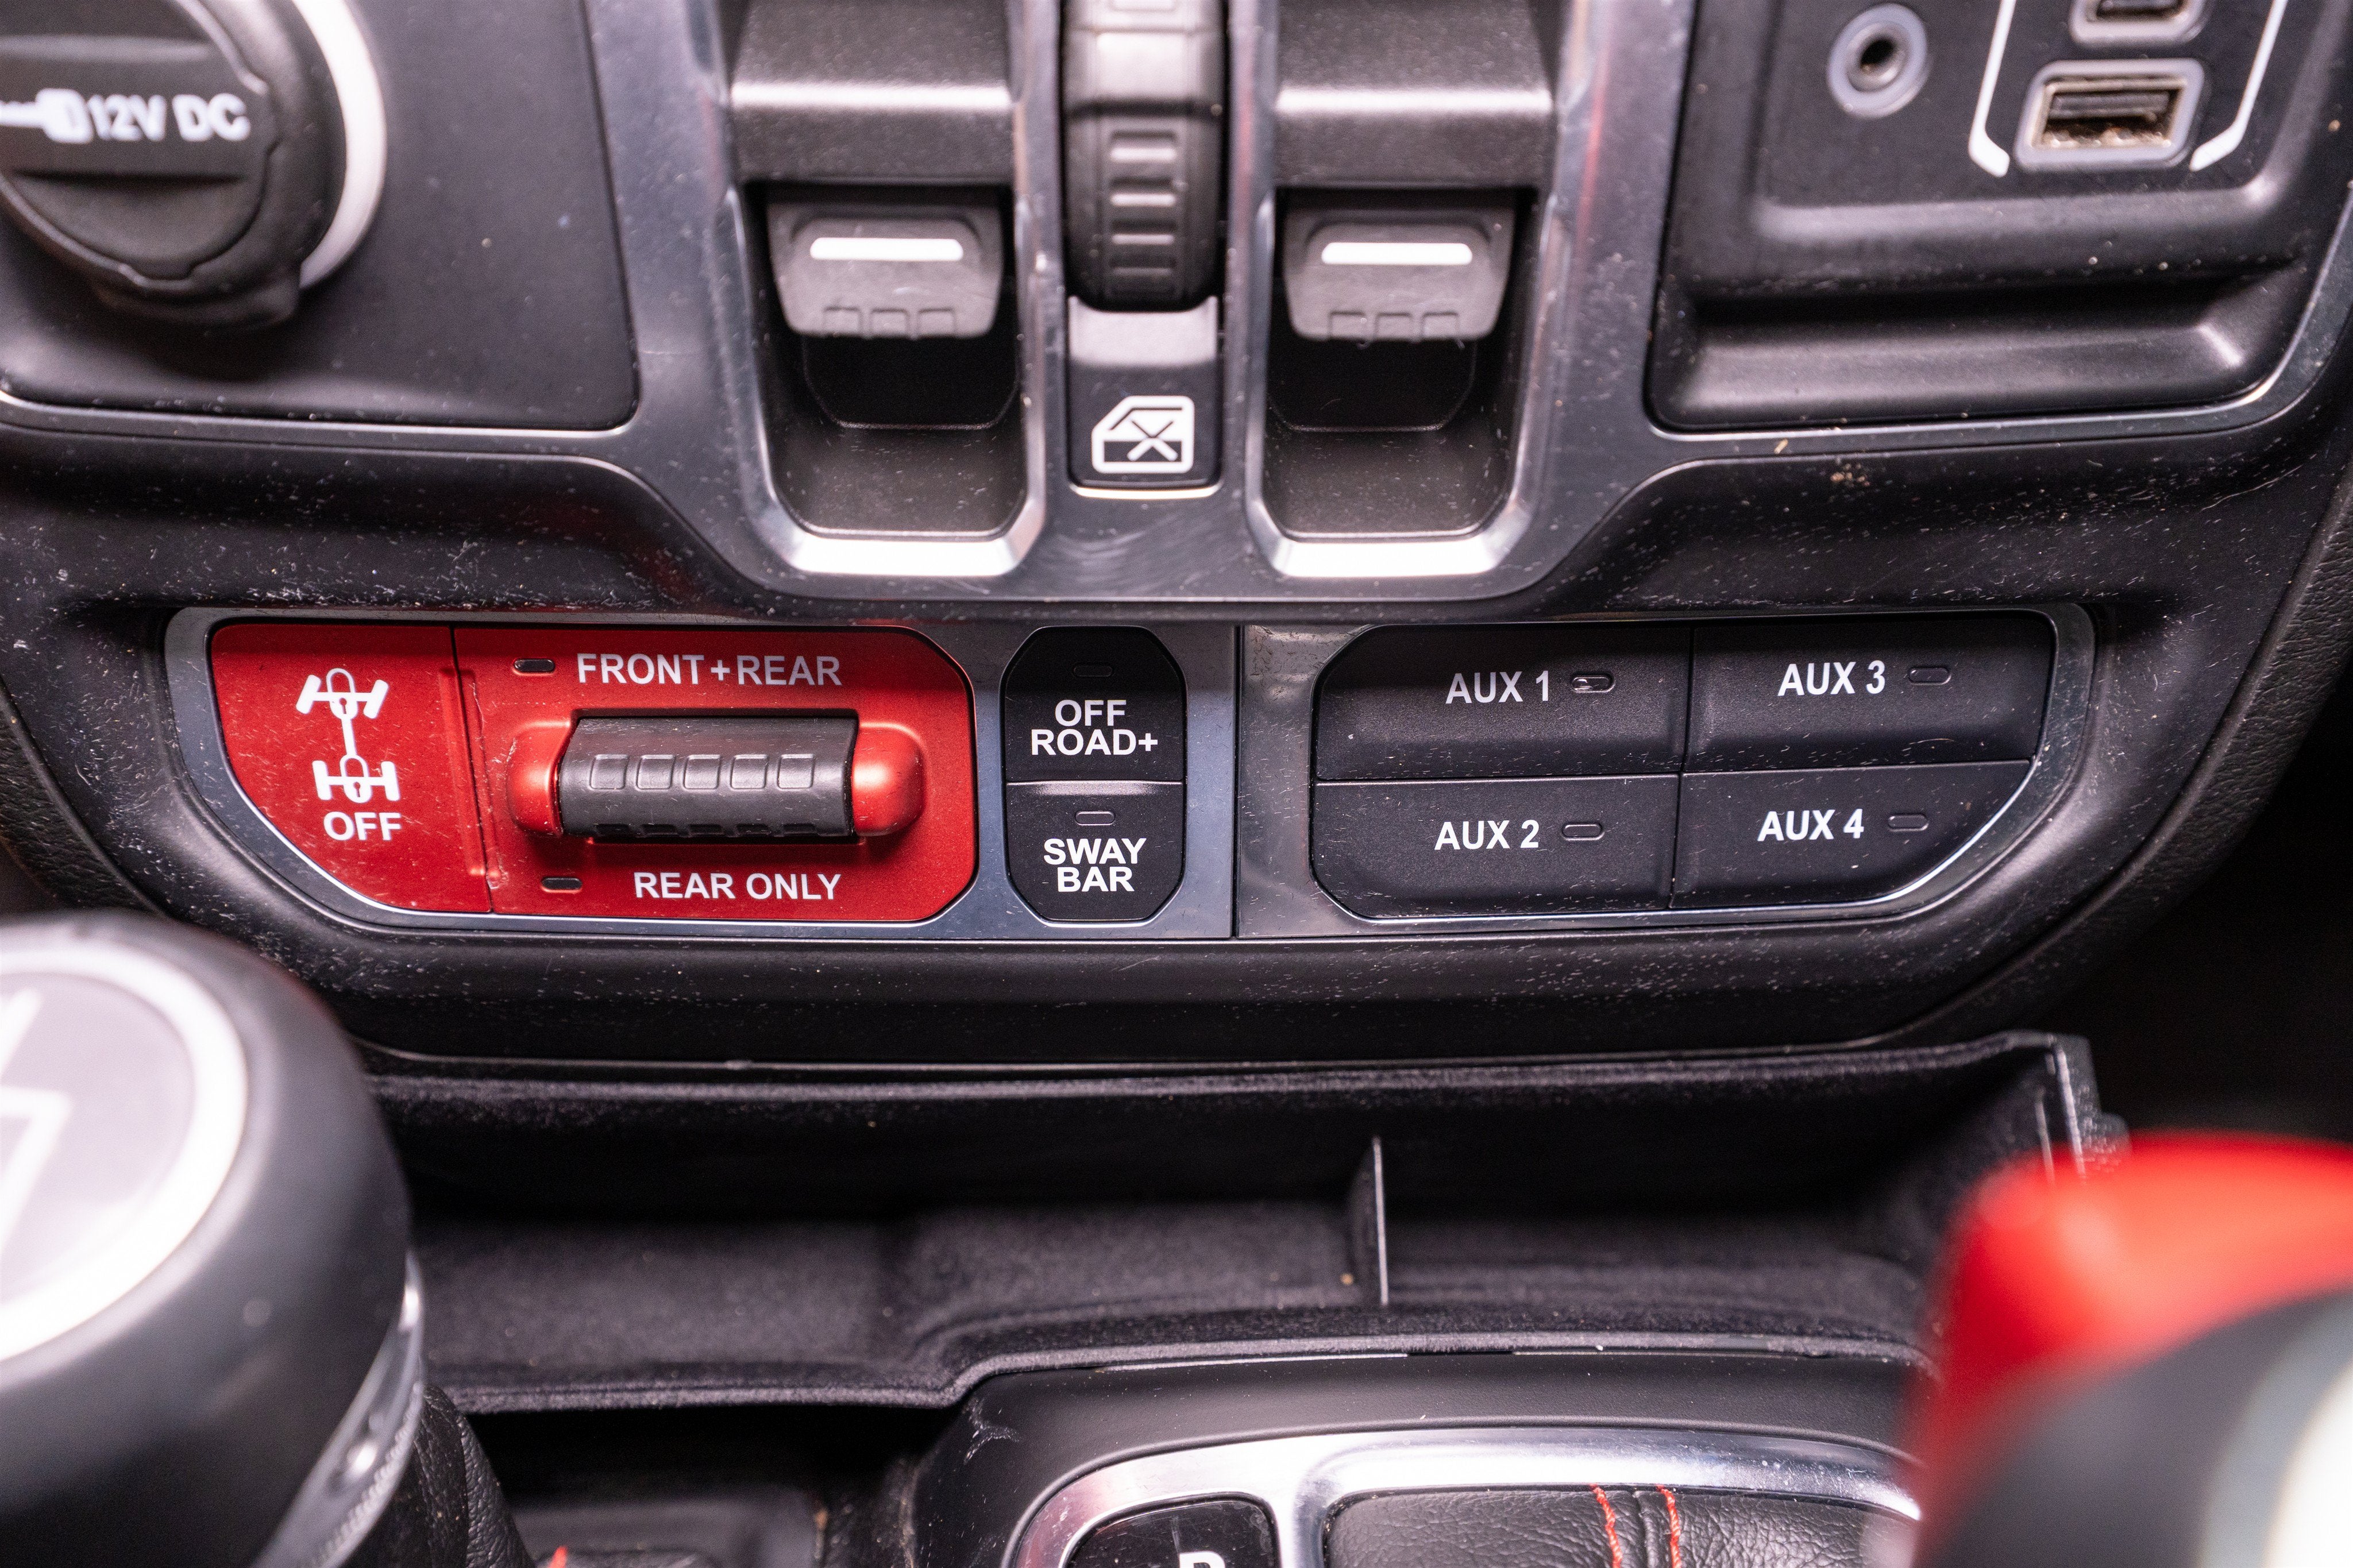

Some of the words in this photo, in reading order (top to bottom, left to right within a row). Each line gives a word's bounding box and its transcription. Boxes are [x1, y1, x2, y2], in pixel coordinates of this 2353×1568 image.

[88, 94, 166, 142] 12V
[172, 92, 250, 141] DC
[1445, 671, 1524, 704] AUX
[1536, 670, 1549, 702] 1
[1777, 661, 1857, 697] AUX
[1866, 660, 1886, 694] 3
[1055, 700, 1127, 727] OFF
[1031, 728, 1158, 756] ROAD+
[323, 811, 402, 841] OFF
[1434, 820, 1510, 851] AUX
[1520, 819, 1540, 848] 2
[1757, 809, 1835, 842] AUX
[1843, 808, 1865, 839] 4
[1043, 837, 1147, 865] SWAY
[634, 872, 736, 899] REAR
[746, 872, 842, 900] ONLY
[1057, 866, 1135, 893] BAR
